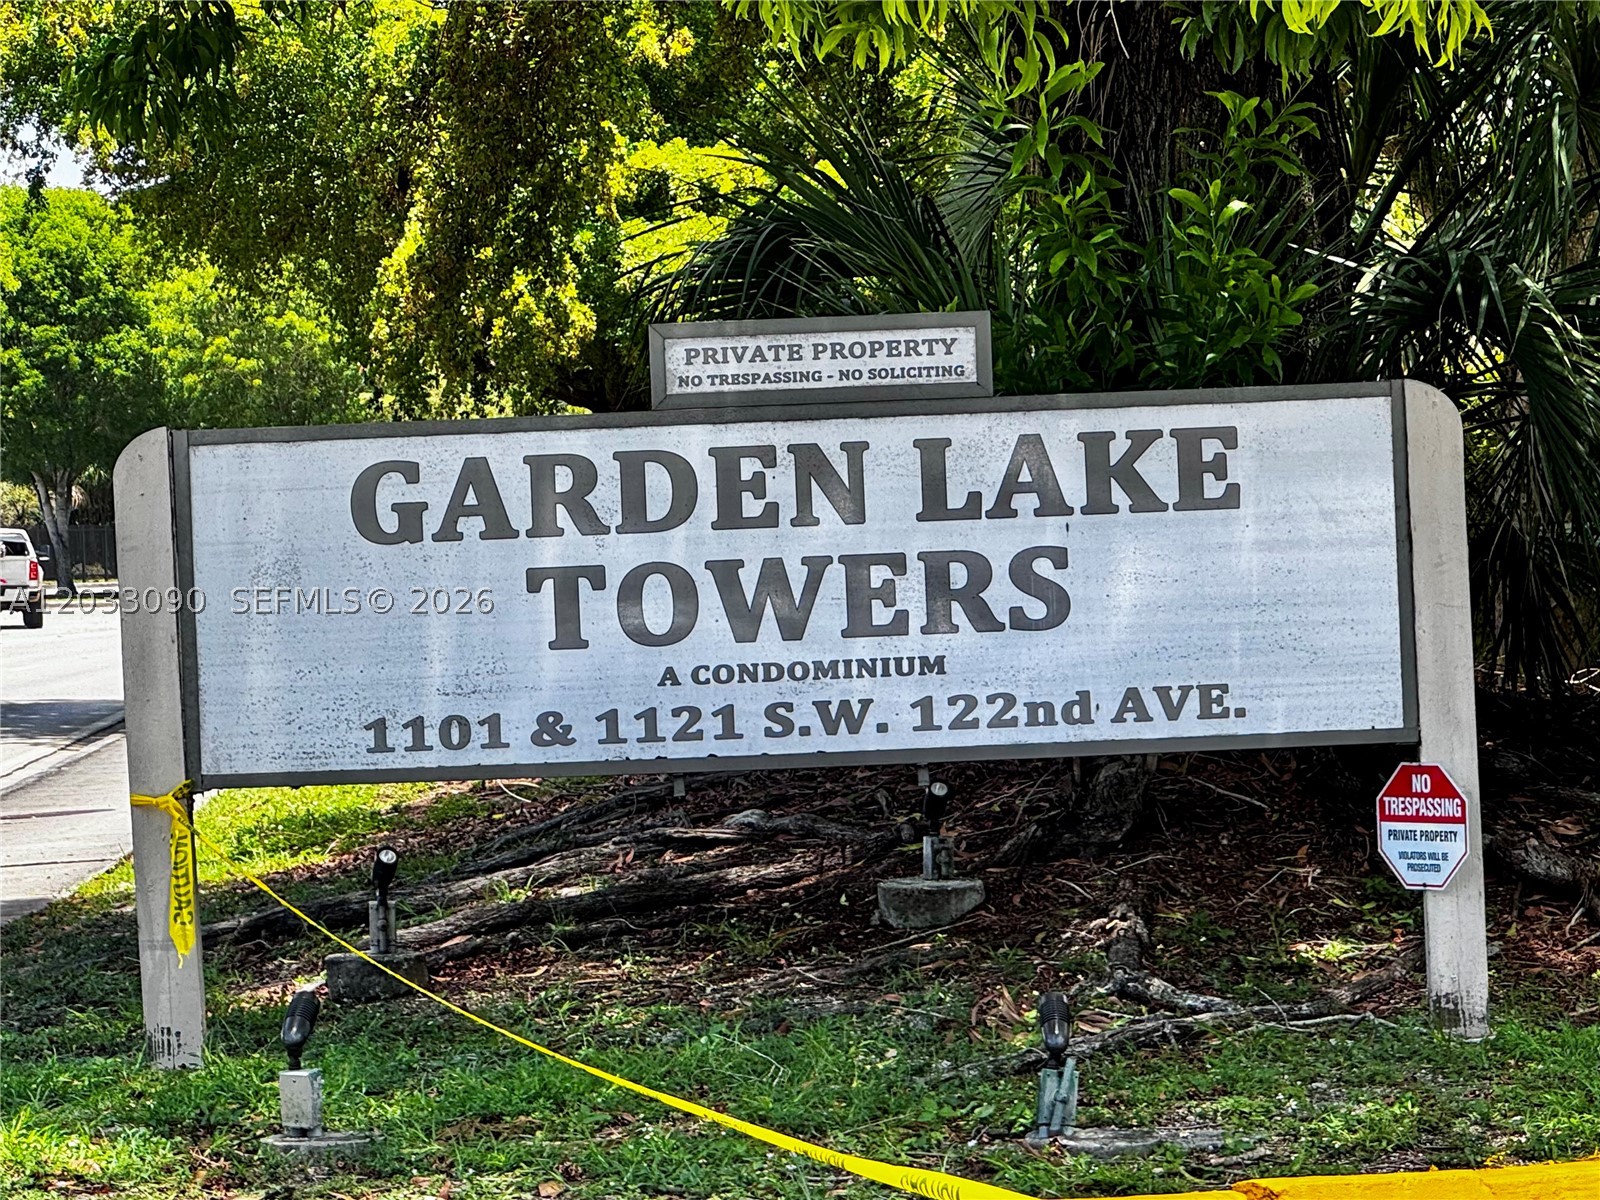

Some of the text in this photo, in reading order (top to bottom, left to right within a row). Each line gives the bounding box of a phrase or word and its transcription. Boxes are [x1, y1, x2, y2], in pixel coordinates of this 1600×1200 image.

[684, 337, 959, 366] PRIVATE PROPERTY
[678, 374, 703, 388] NO
[707, 370, 823, 386] TRESPASSING
[839, 369, 864, 381] NO
[868, 364, 966, 380] SOLICITING
[351, 426, 1240, 545] GARDEN LAKE
[526, 545, 1072, 650] TOWERS
[656, 655, 948, 687] A CONDOMINIUM
[364, 684, 1247, 753] 1101 & 1121 S.W. 122nd AVE.
[1411, 774, 1431, 793] NO
[1383, 797, 1462, 817] TRESPASSING
[1388, 829, 1458, 842] PRIVATE PROPERTY
[1398, 851, 1449, 861] VIOLATORS WILL BE
[1407, 863, 1442, 872] PROSECUTED
